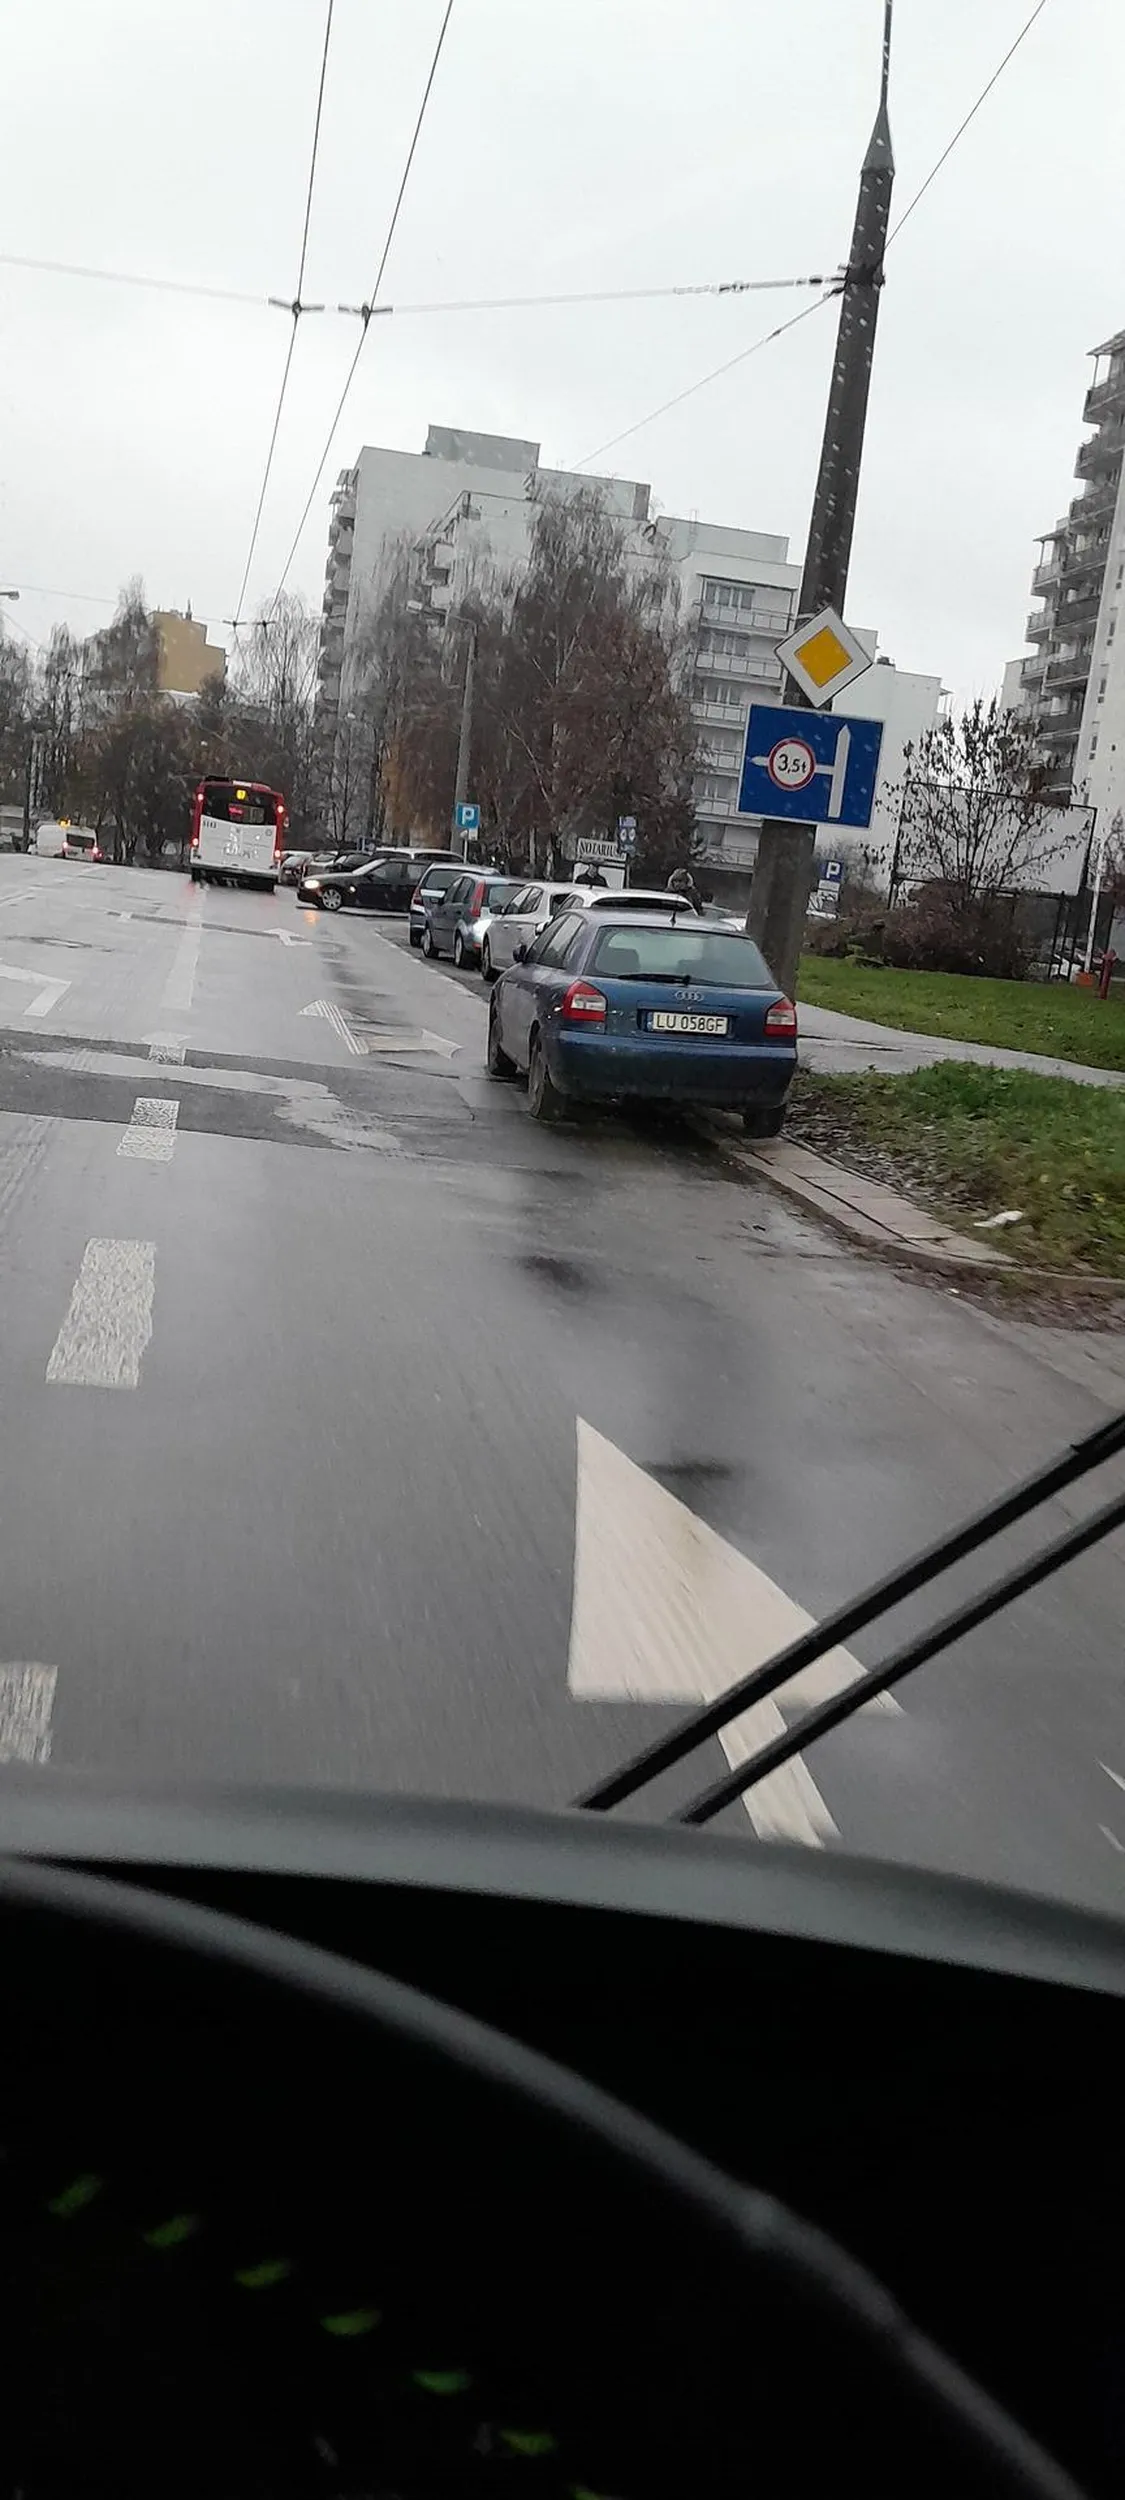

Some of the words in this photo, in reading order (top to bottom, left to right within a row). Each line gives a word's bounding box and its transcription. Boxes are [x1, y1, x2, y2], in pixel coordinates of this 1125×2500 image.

[778, 753, 806, 774] 3,5t
[461, 806, 474, 825] P
[826, 861, 840, 878] P
[656, 1014, 676, 1028] LU
[681, 1015, 724, 1031] 058GF
